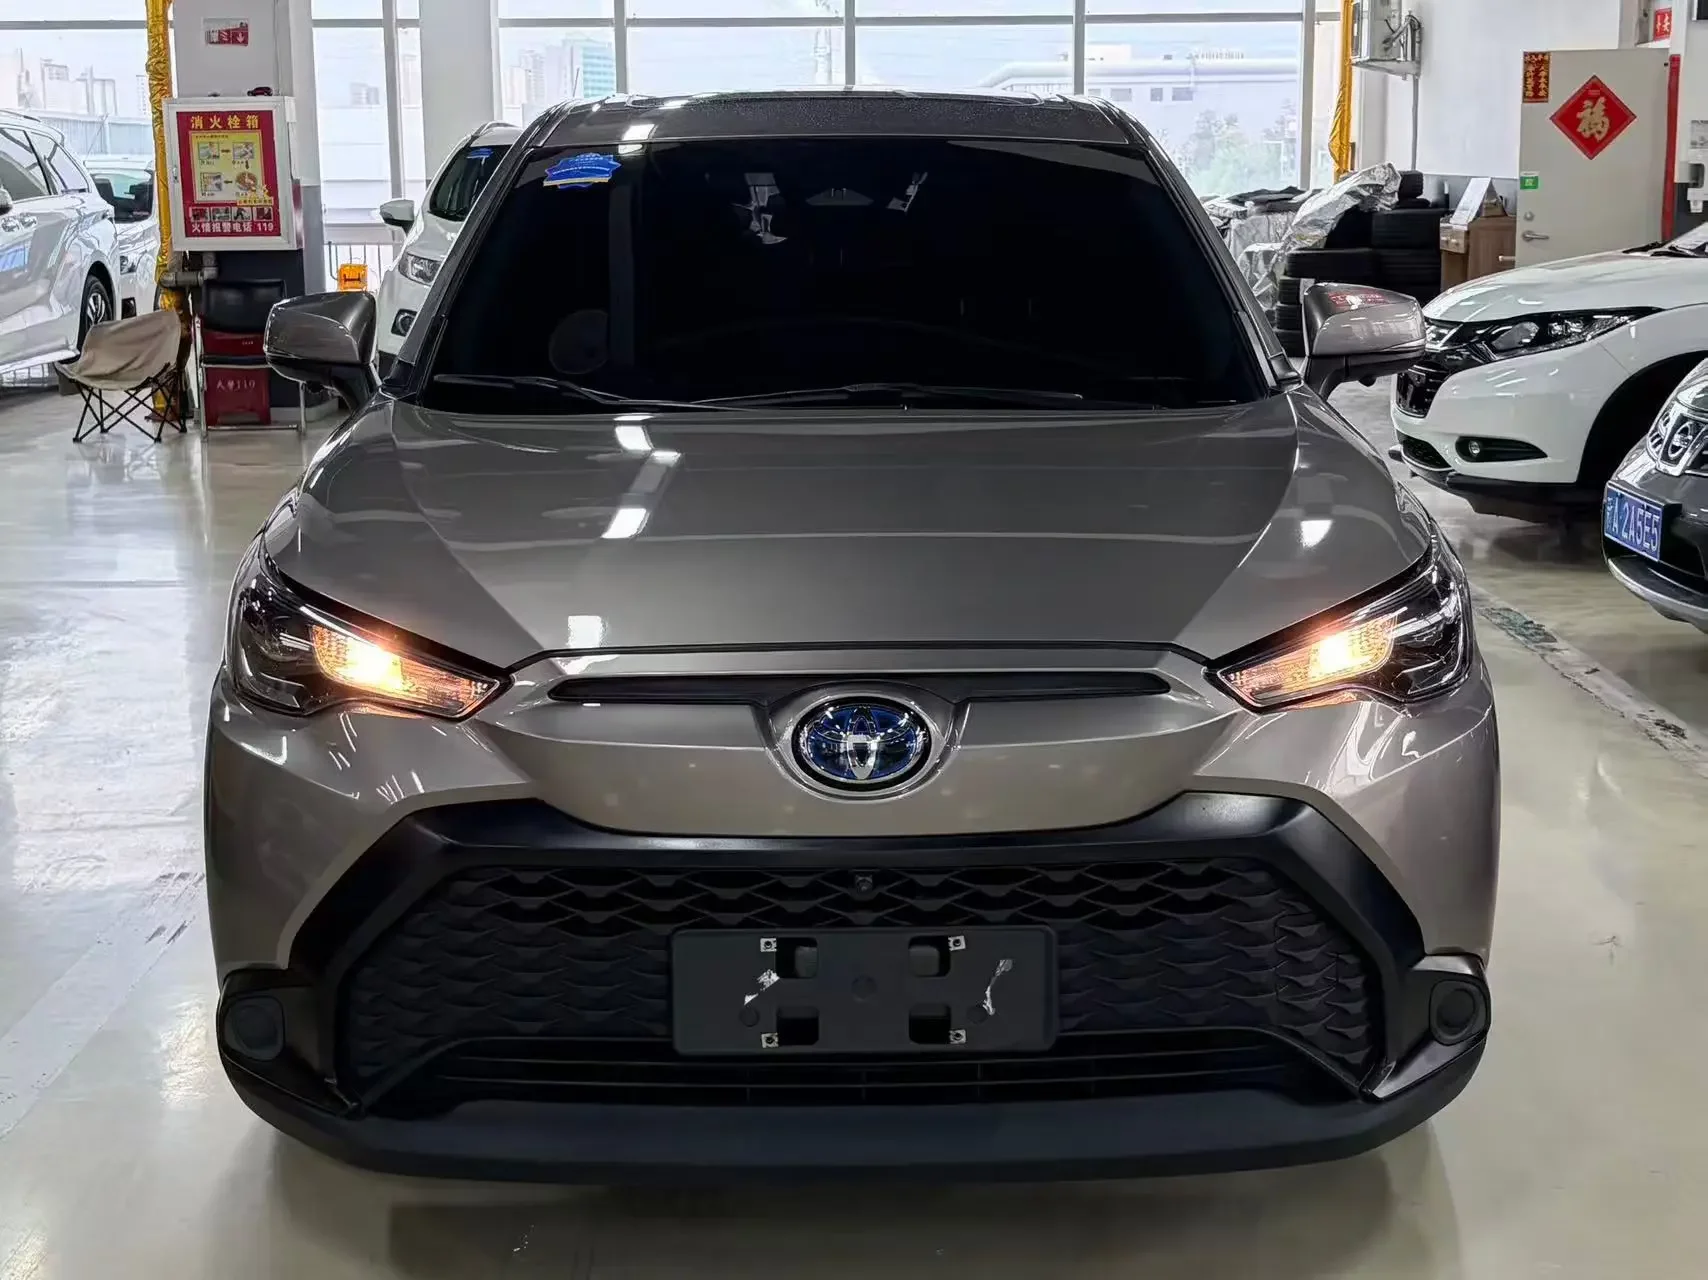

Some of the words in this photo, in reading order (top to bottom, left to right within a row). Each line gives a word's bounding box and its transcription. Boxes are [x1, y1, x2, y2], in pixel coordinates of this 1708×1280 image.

[191, 115, 259, 129] 消火栓箱
[1576, 97, 1610, 142] 福
[257, 223, 274, 232] 119
